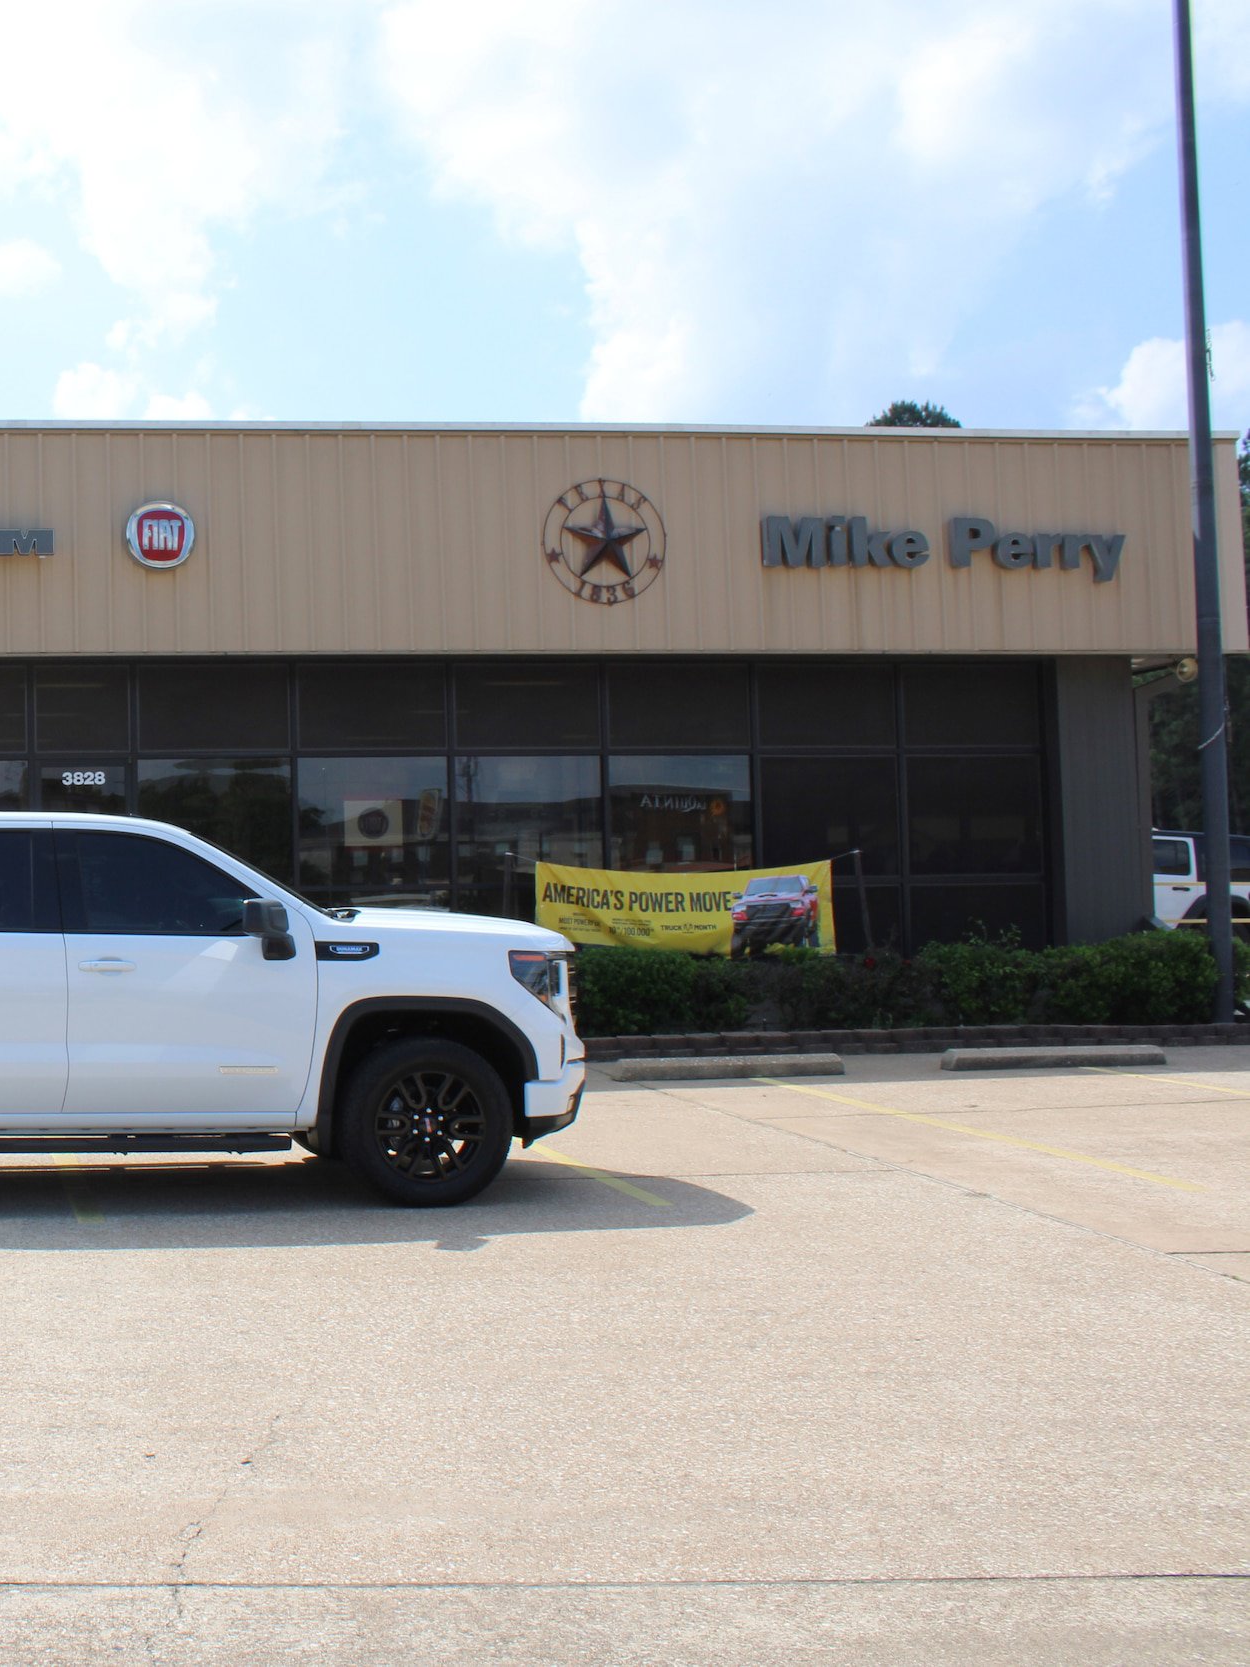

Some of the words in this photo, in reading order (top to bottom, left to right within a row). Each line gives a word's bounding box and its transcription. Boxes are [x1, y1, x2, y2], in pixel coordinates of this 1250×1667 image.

[556, 479, 648, 514] TEXAS
[142, 519, 182, 551] FIAT
[762, 515, 931, 569] Mike
[947, 516, 1126, 583] Perry
[575, 580, 636, 606] 1836
[61, 771, 106, 786] 3828
[542, 882, 624, 911] AMERICA'S
[629, 891, 686, 912] POWER
[689, 891, 732, 912] MOVE
